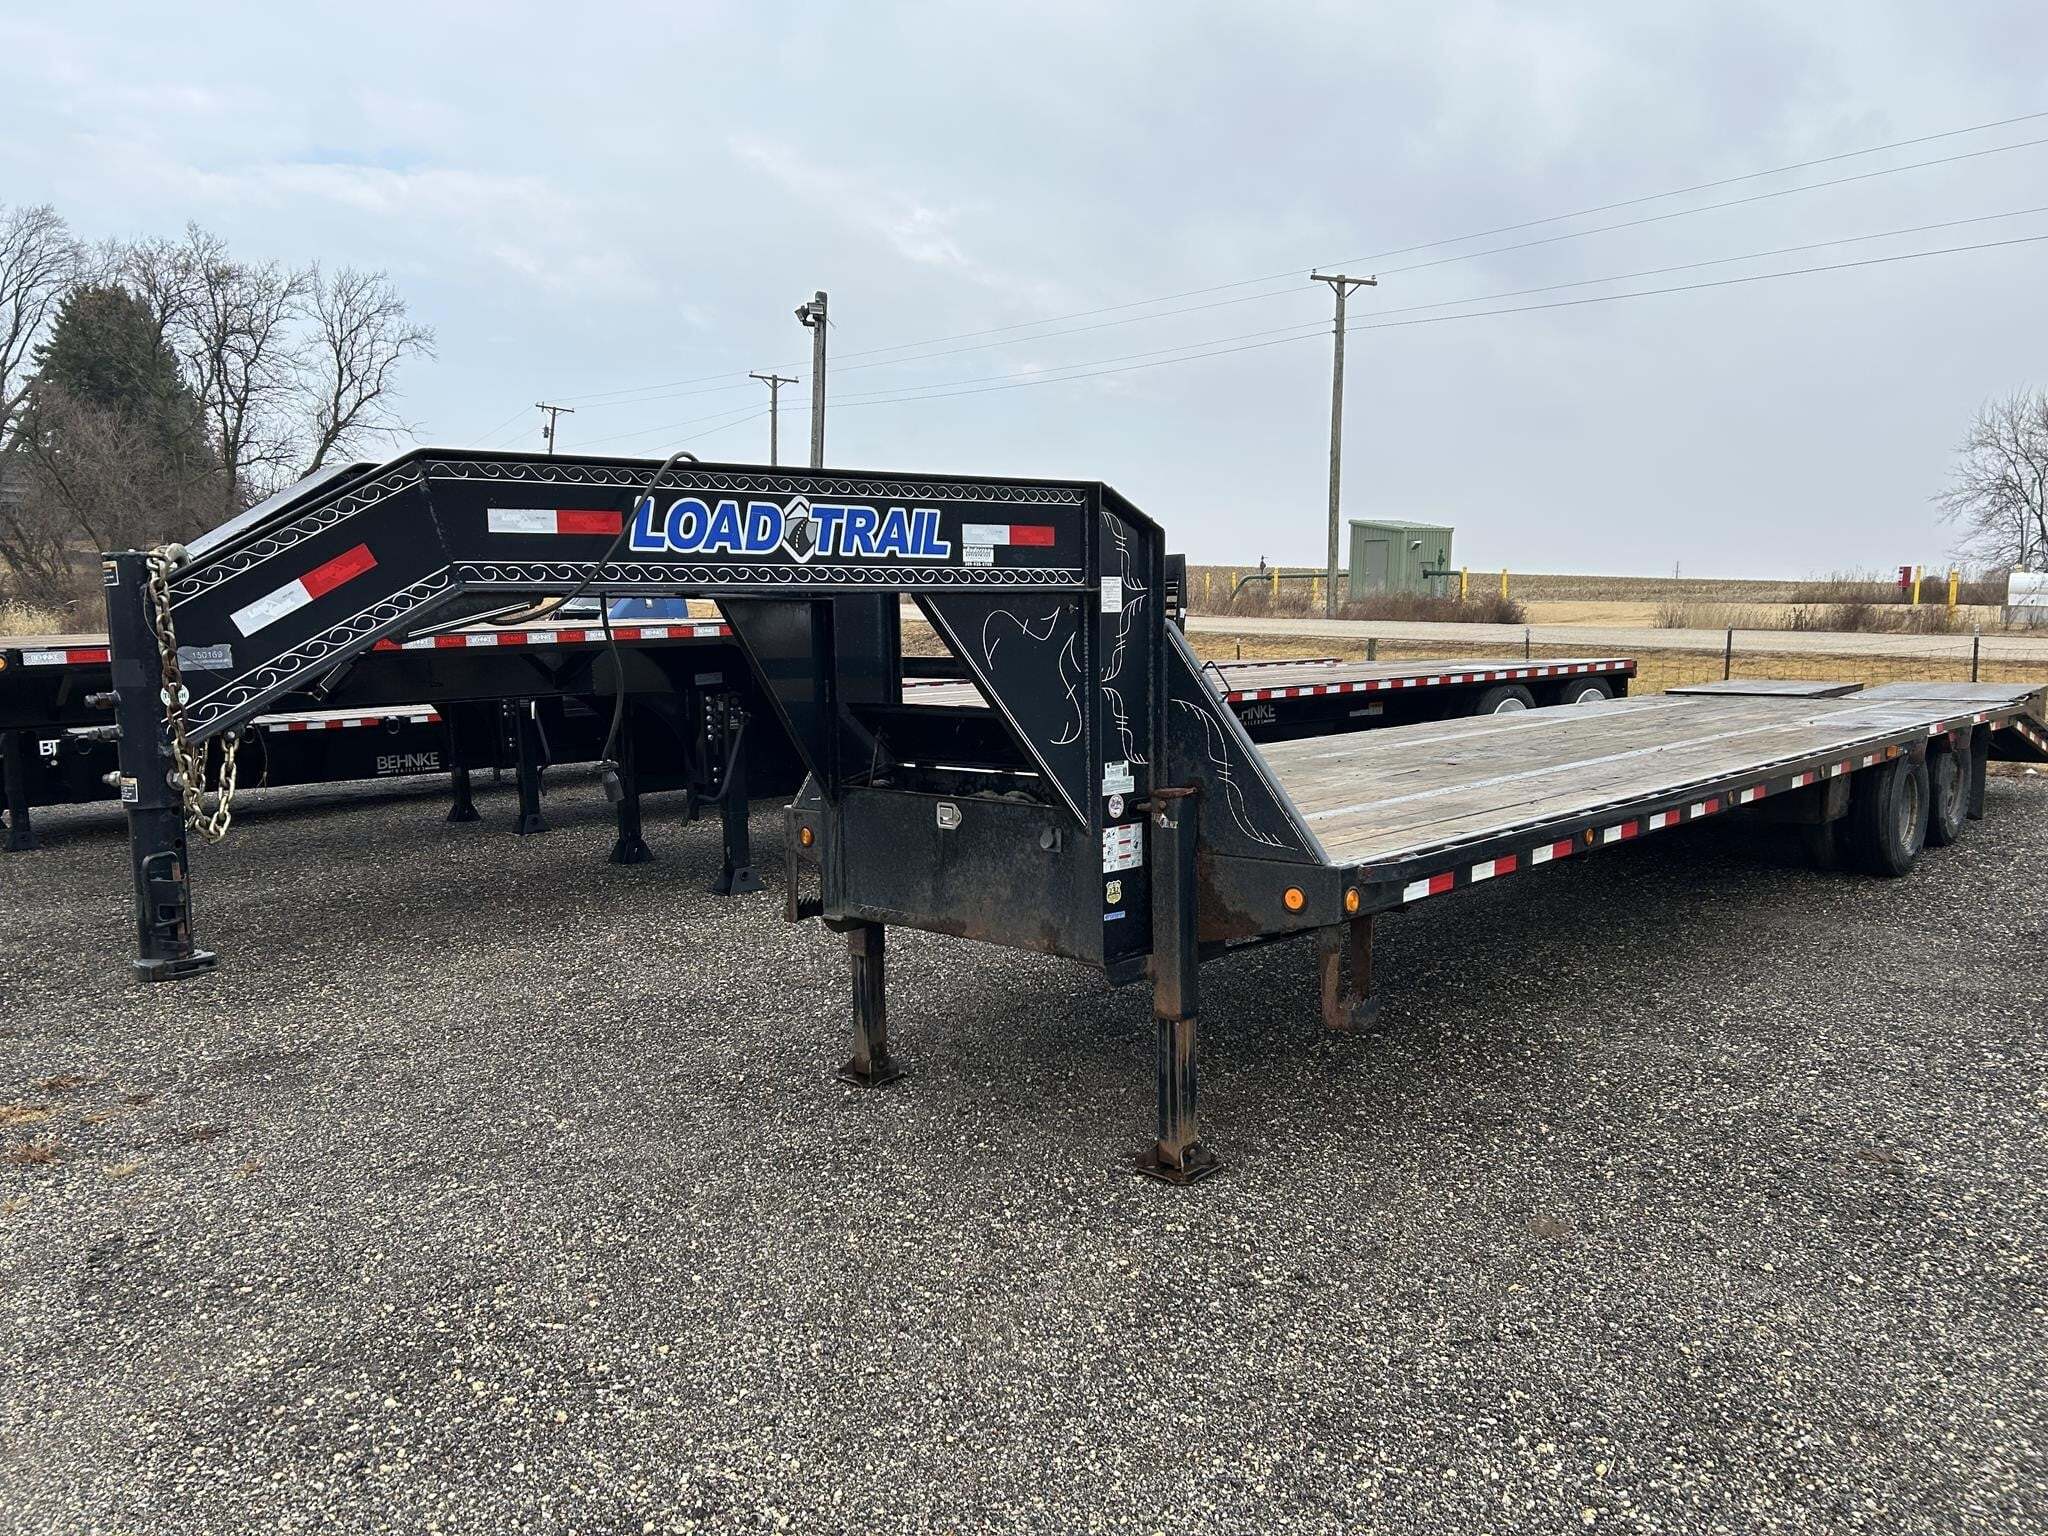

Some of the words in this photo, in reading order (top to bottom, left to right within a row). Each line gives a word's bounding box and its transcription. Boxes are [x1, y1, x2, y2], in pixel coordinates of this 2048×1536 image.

[629, 496, 783, 554] LOAD
[808, 504, 951, 558] TRAIL
[39, 739, 61, 757] BT
[377, 752, 440, 770] BEHNKE
